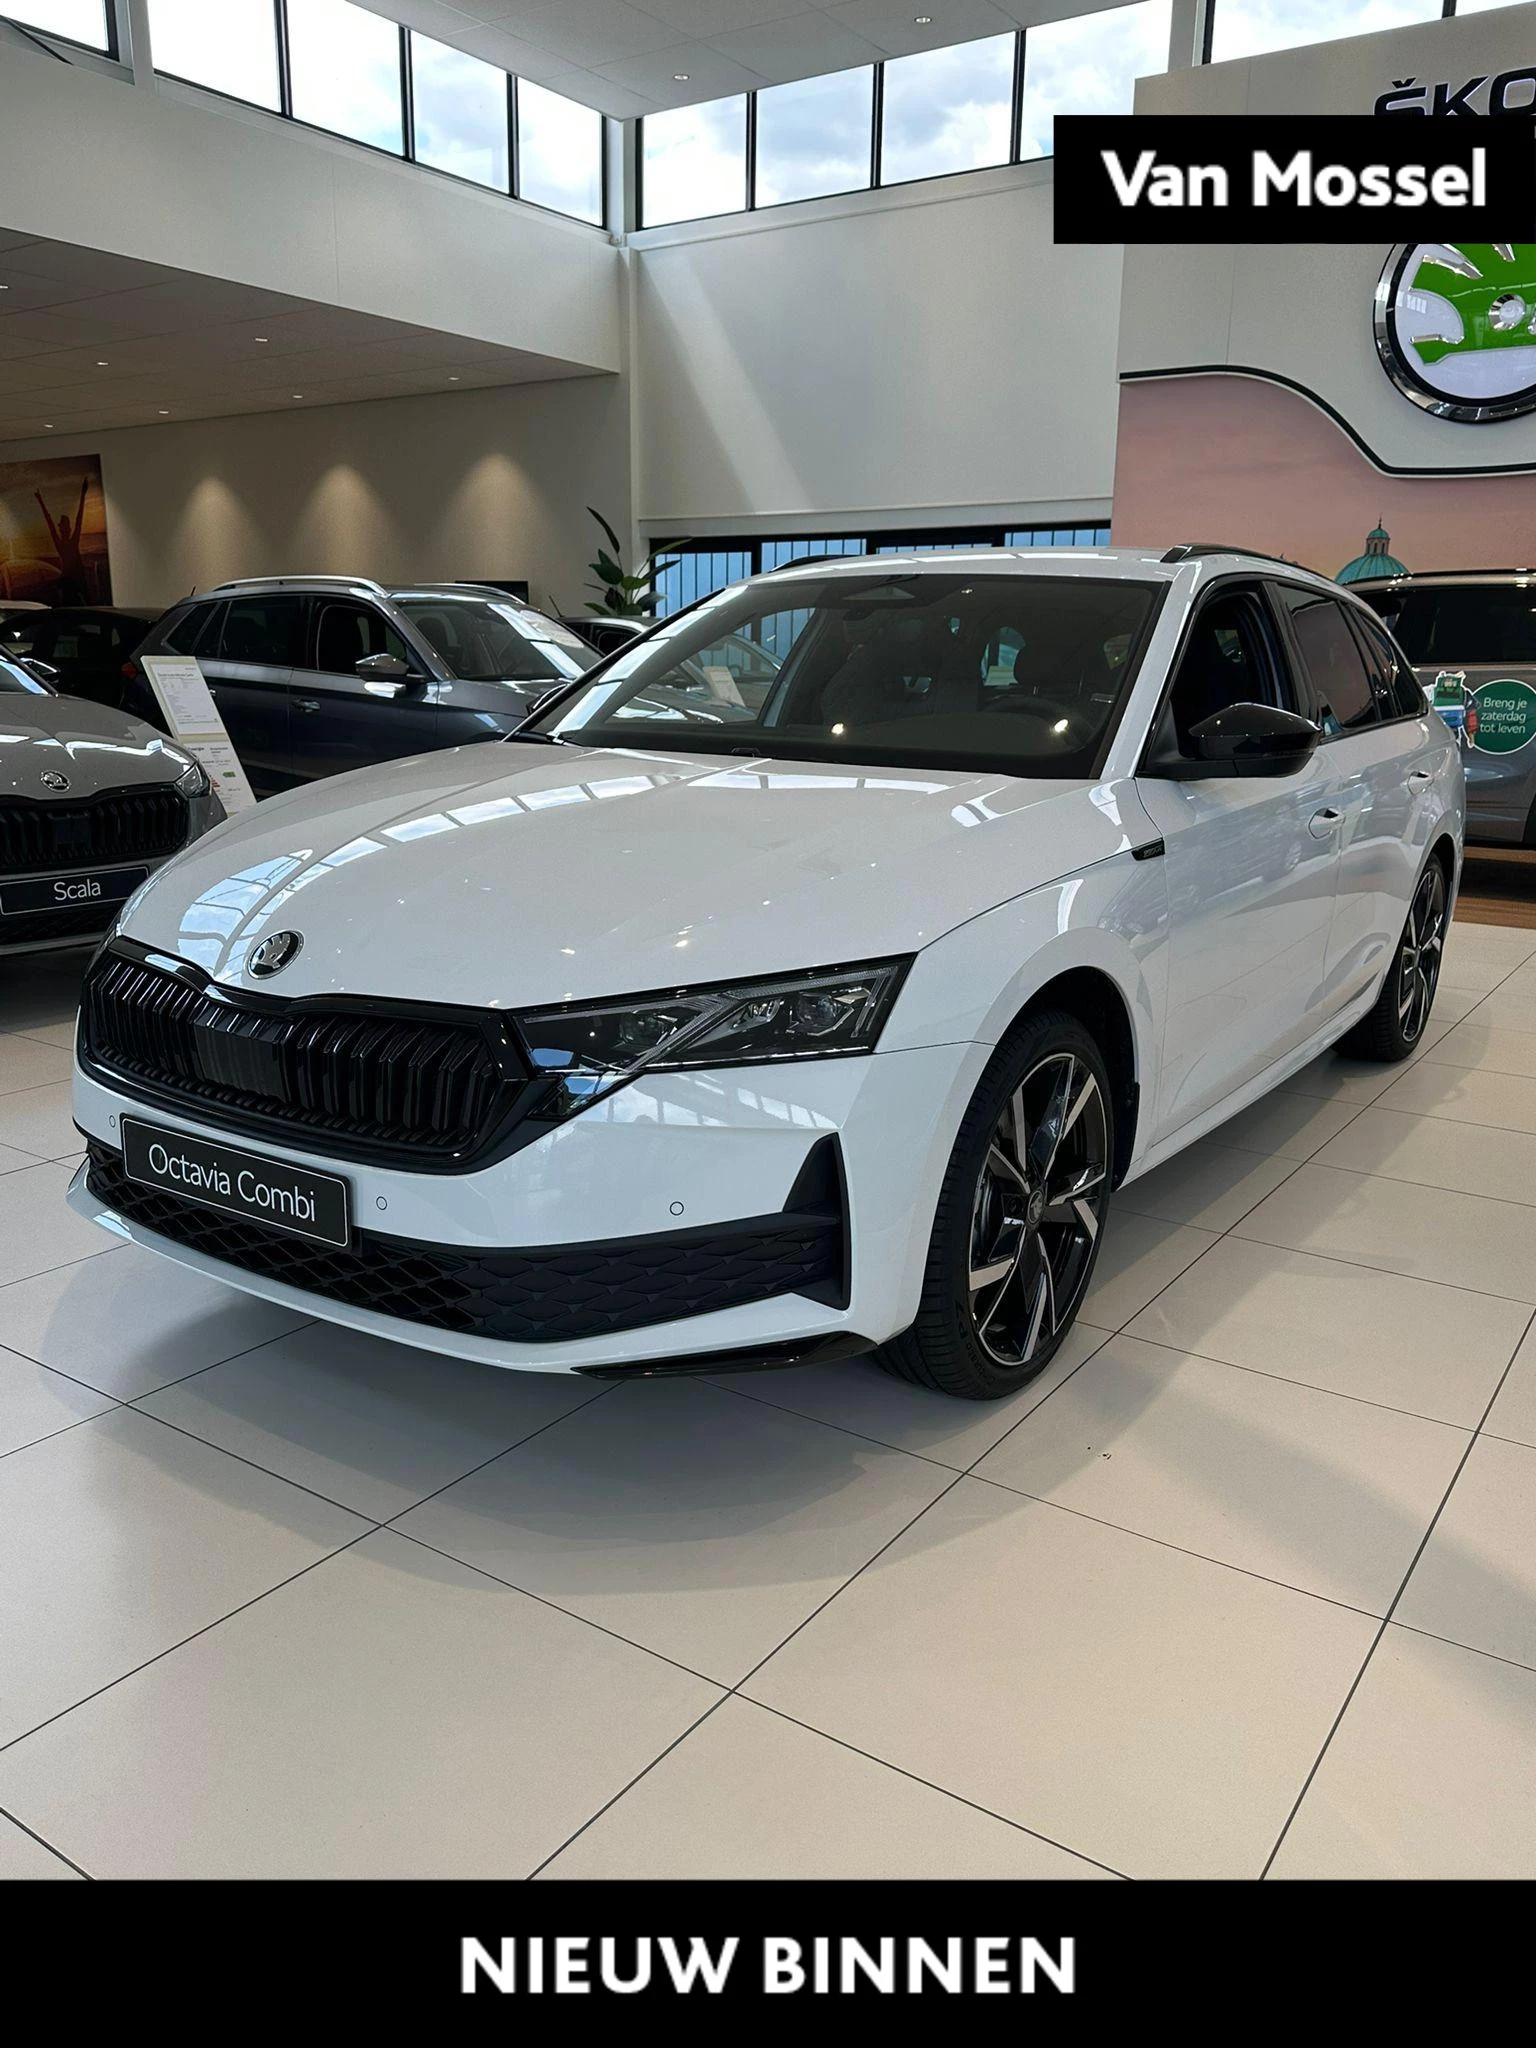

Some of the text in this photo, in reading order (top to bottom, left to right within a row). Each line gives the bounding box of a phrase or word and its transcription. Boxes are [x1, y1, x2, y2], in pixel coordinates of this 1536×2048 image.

[1483, 697, 1527, 710] Breng je
[1481, 711, 1527, 724] zaterdag
[1480, 722, 1526, 734] tot leven
[53, 879, 102, 901] Scala
[148, 1143, 316, 1222] Octavia Combi
